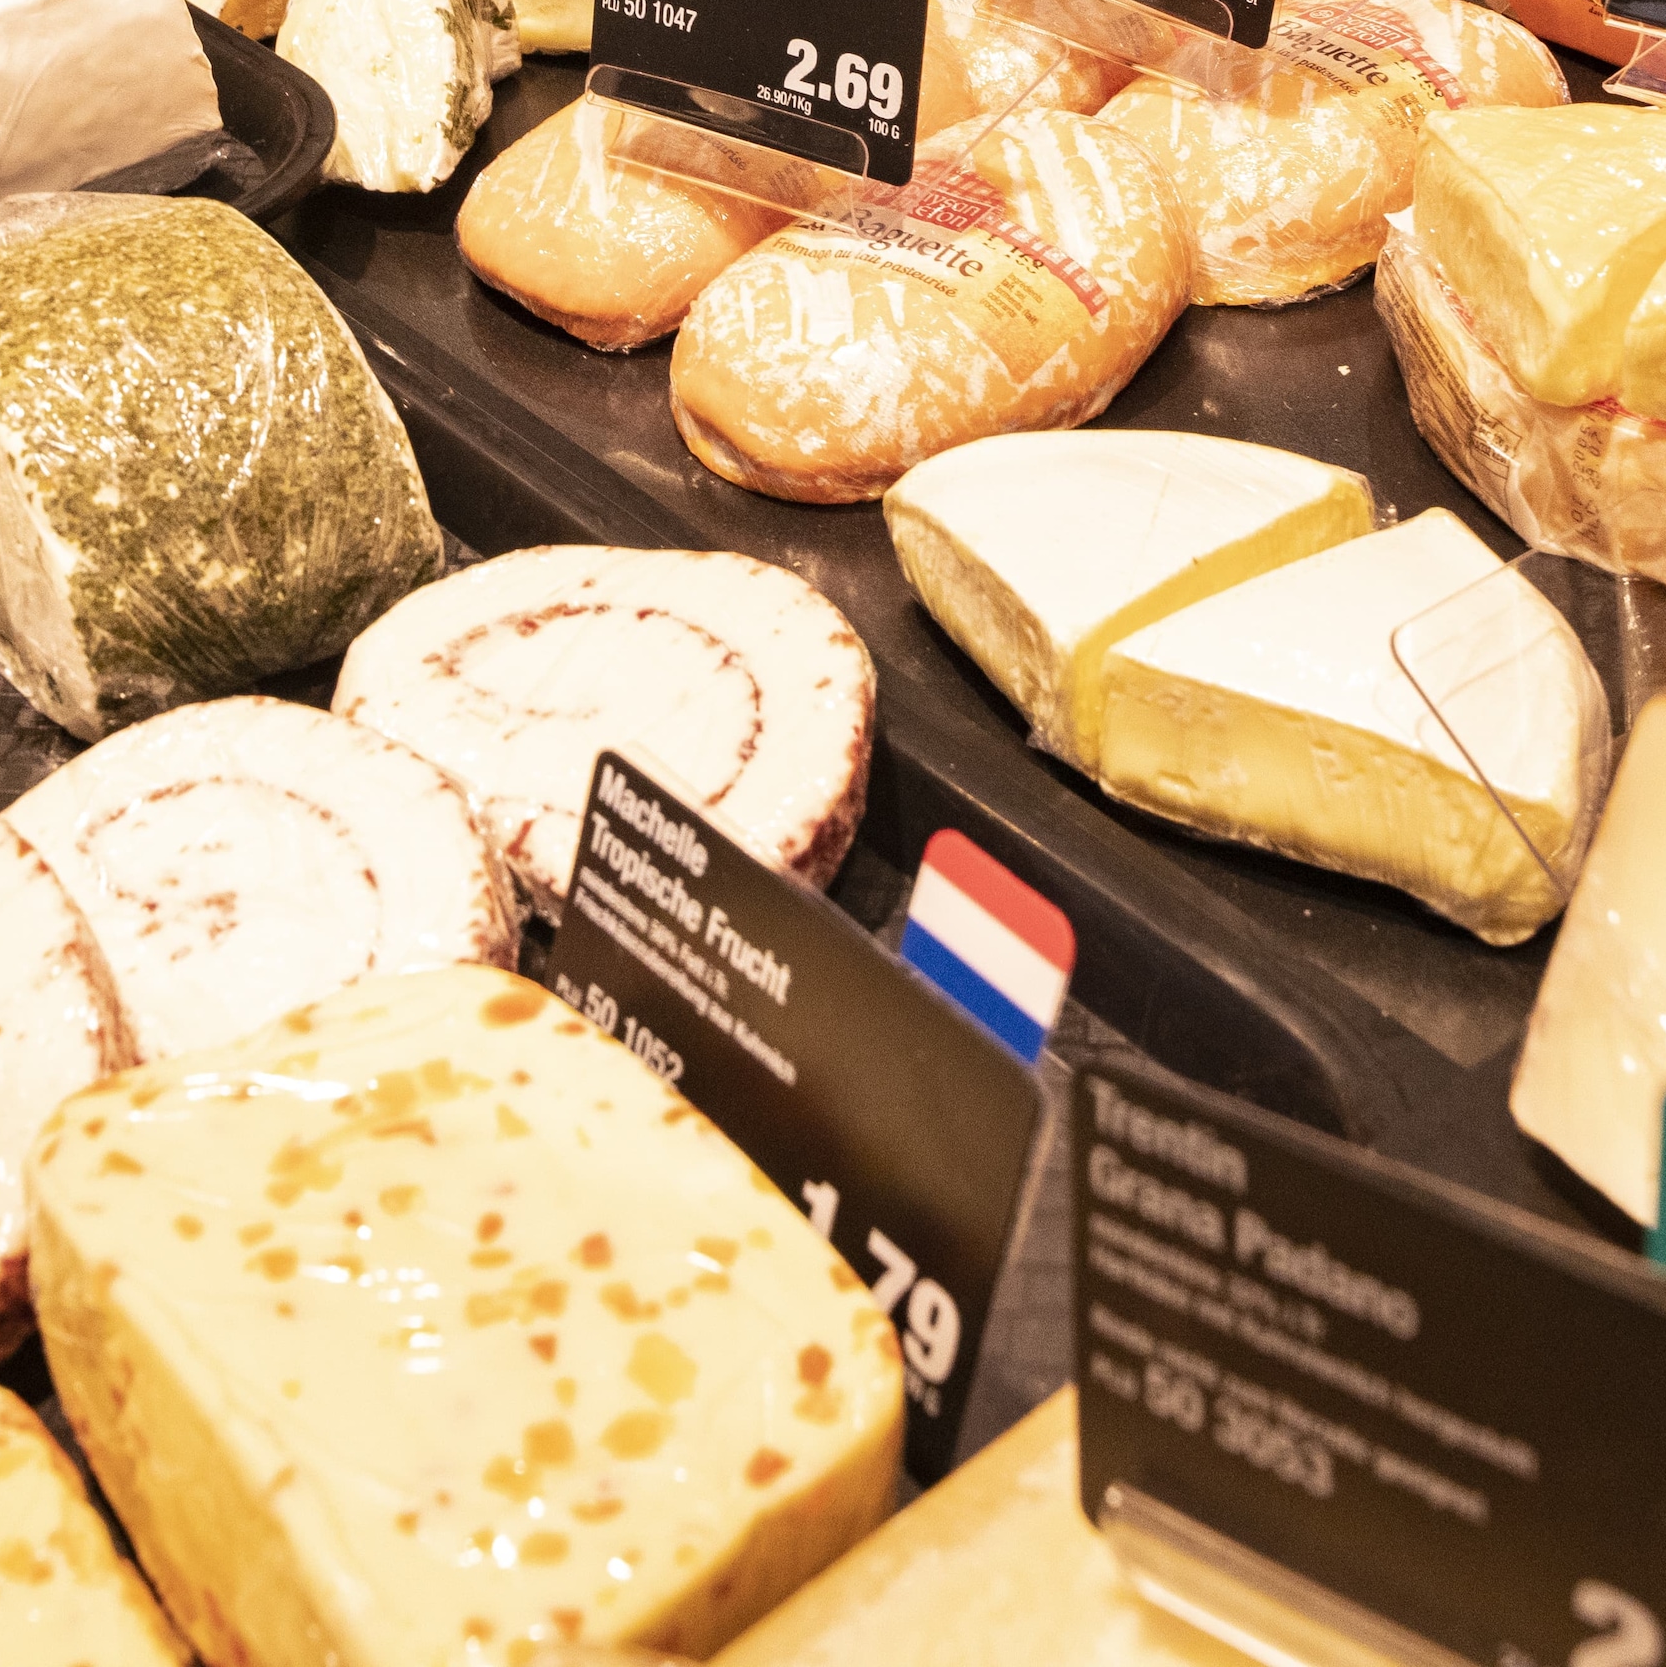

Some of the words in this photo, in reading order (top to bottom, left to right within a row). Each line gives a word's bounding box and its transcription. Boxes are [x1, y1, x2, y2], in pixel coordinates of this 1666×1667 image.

[653, 1, 697, 32] 1047
[757, 84, 812, 115] 26.90/1Kg
[783, 38, 903, 120] 2.69
[868, 118, 888, 136] 100
[891, 124, 900, 139] G
[774, 237, 831, 260] Fromage
[834, 247, 851, 259] au
[856, 248, 881, 265] lait
[883, 257, 958, 298] pasteurisé
[840, 206, 983, 278] Baguette
[597, 763, 709, 877] Machelle
[590, 810, 704, 934] Tropische
[704, 906, 791, 1006] Frucht
